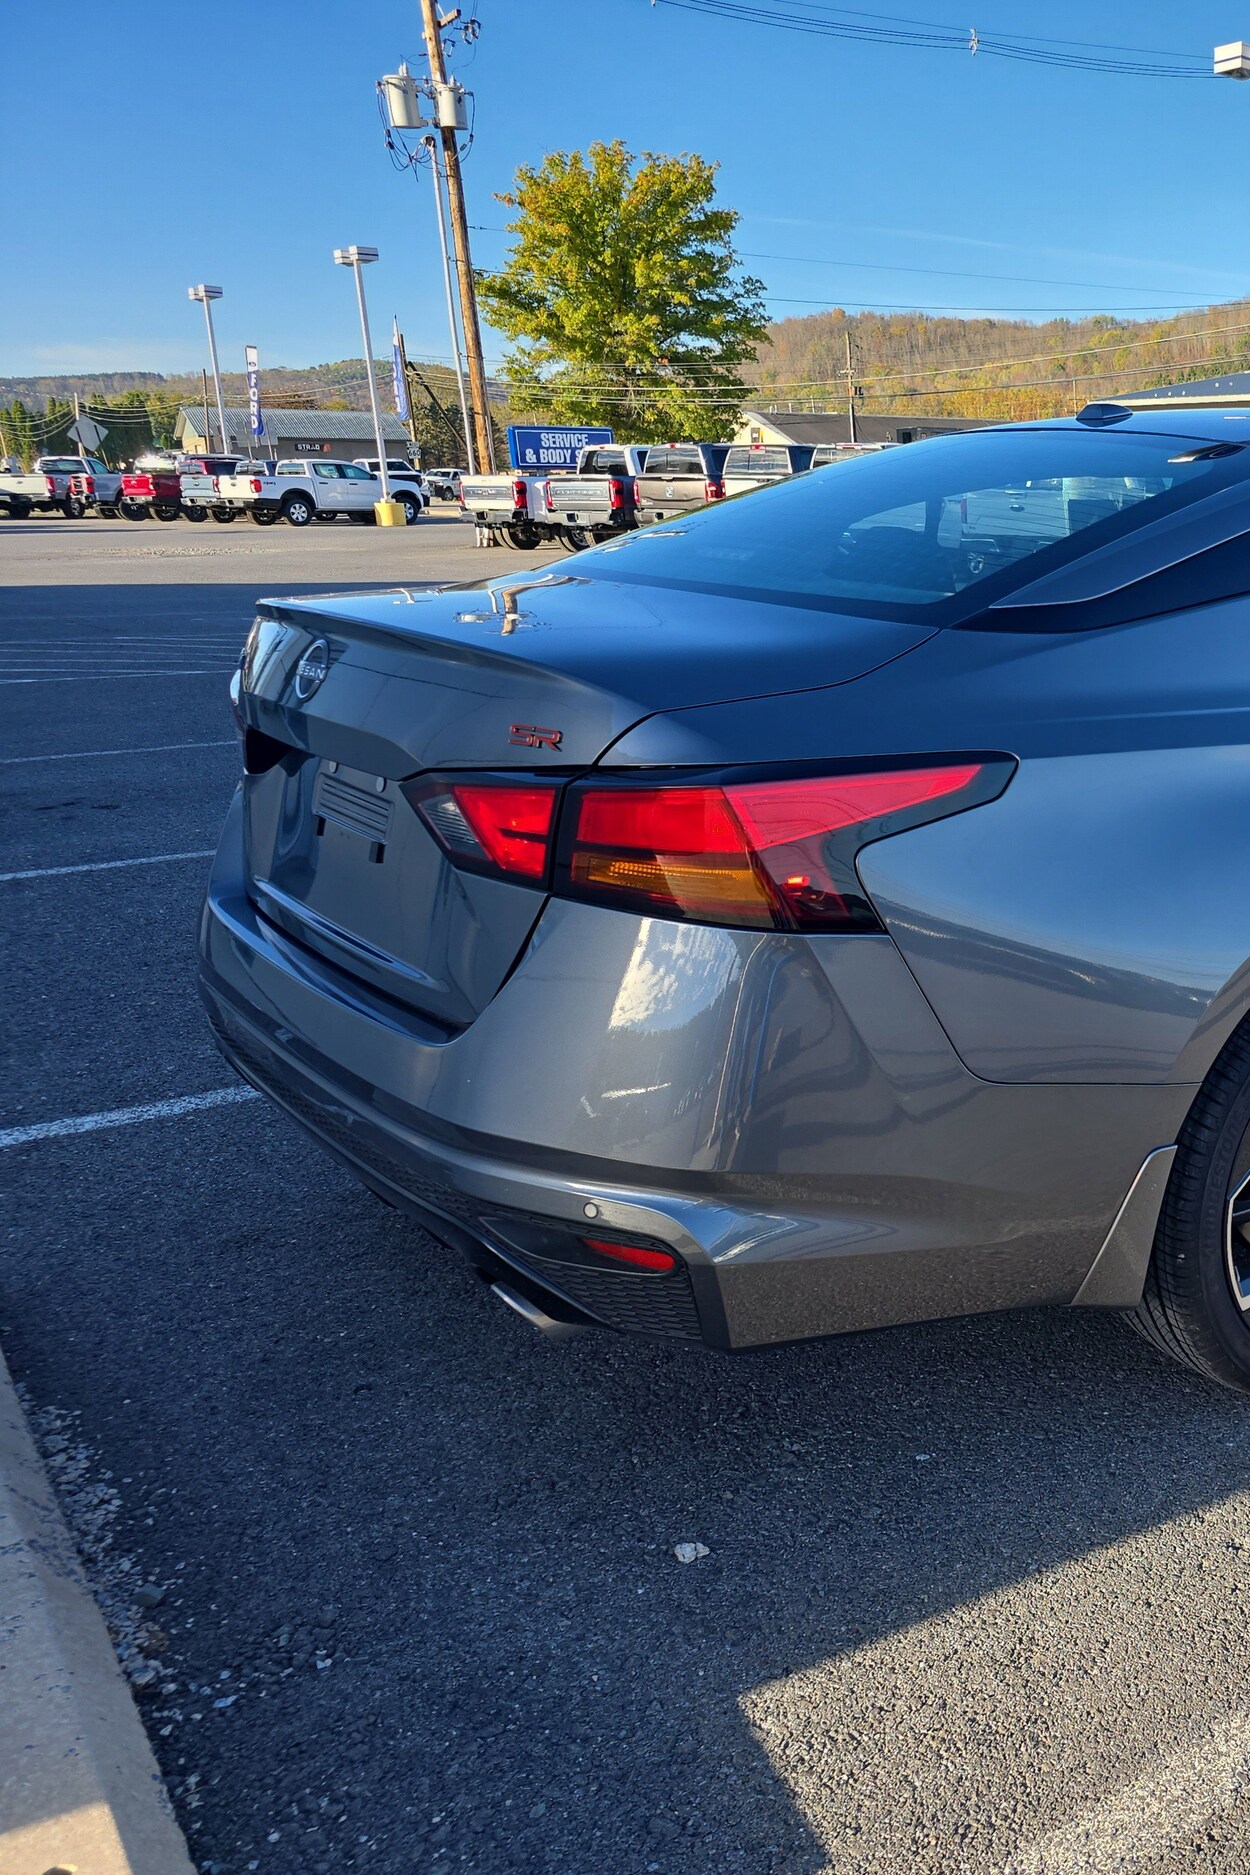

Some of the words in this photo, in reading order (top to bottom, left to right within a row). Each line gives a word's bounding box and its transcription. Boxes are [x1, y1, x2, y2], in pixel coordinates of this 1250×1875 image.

[249, 374, 259, 429] FORD
[540, 432, 588, 448] SERVICE
[408, 449, 421, 457] 660
[525, 450, 537, 463] &
[540, 449, 572, 463] BODY
[508, 724, 563, 752] SR
